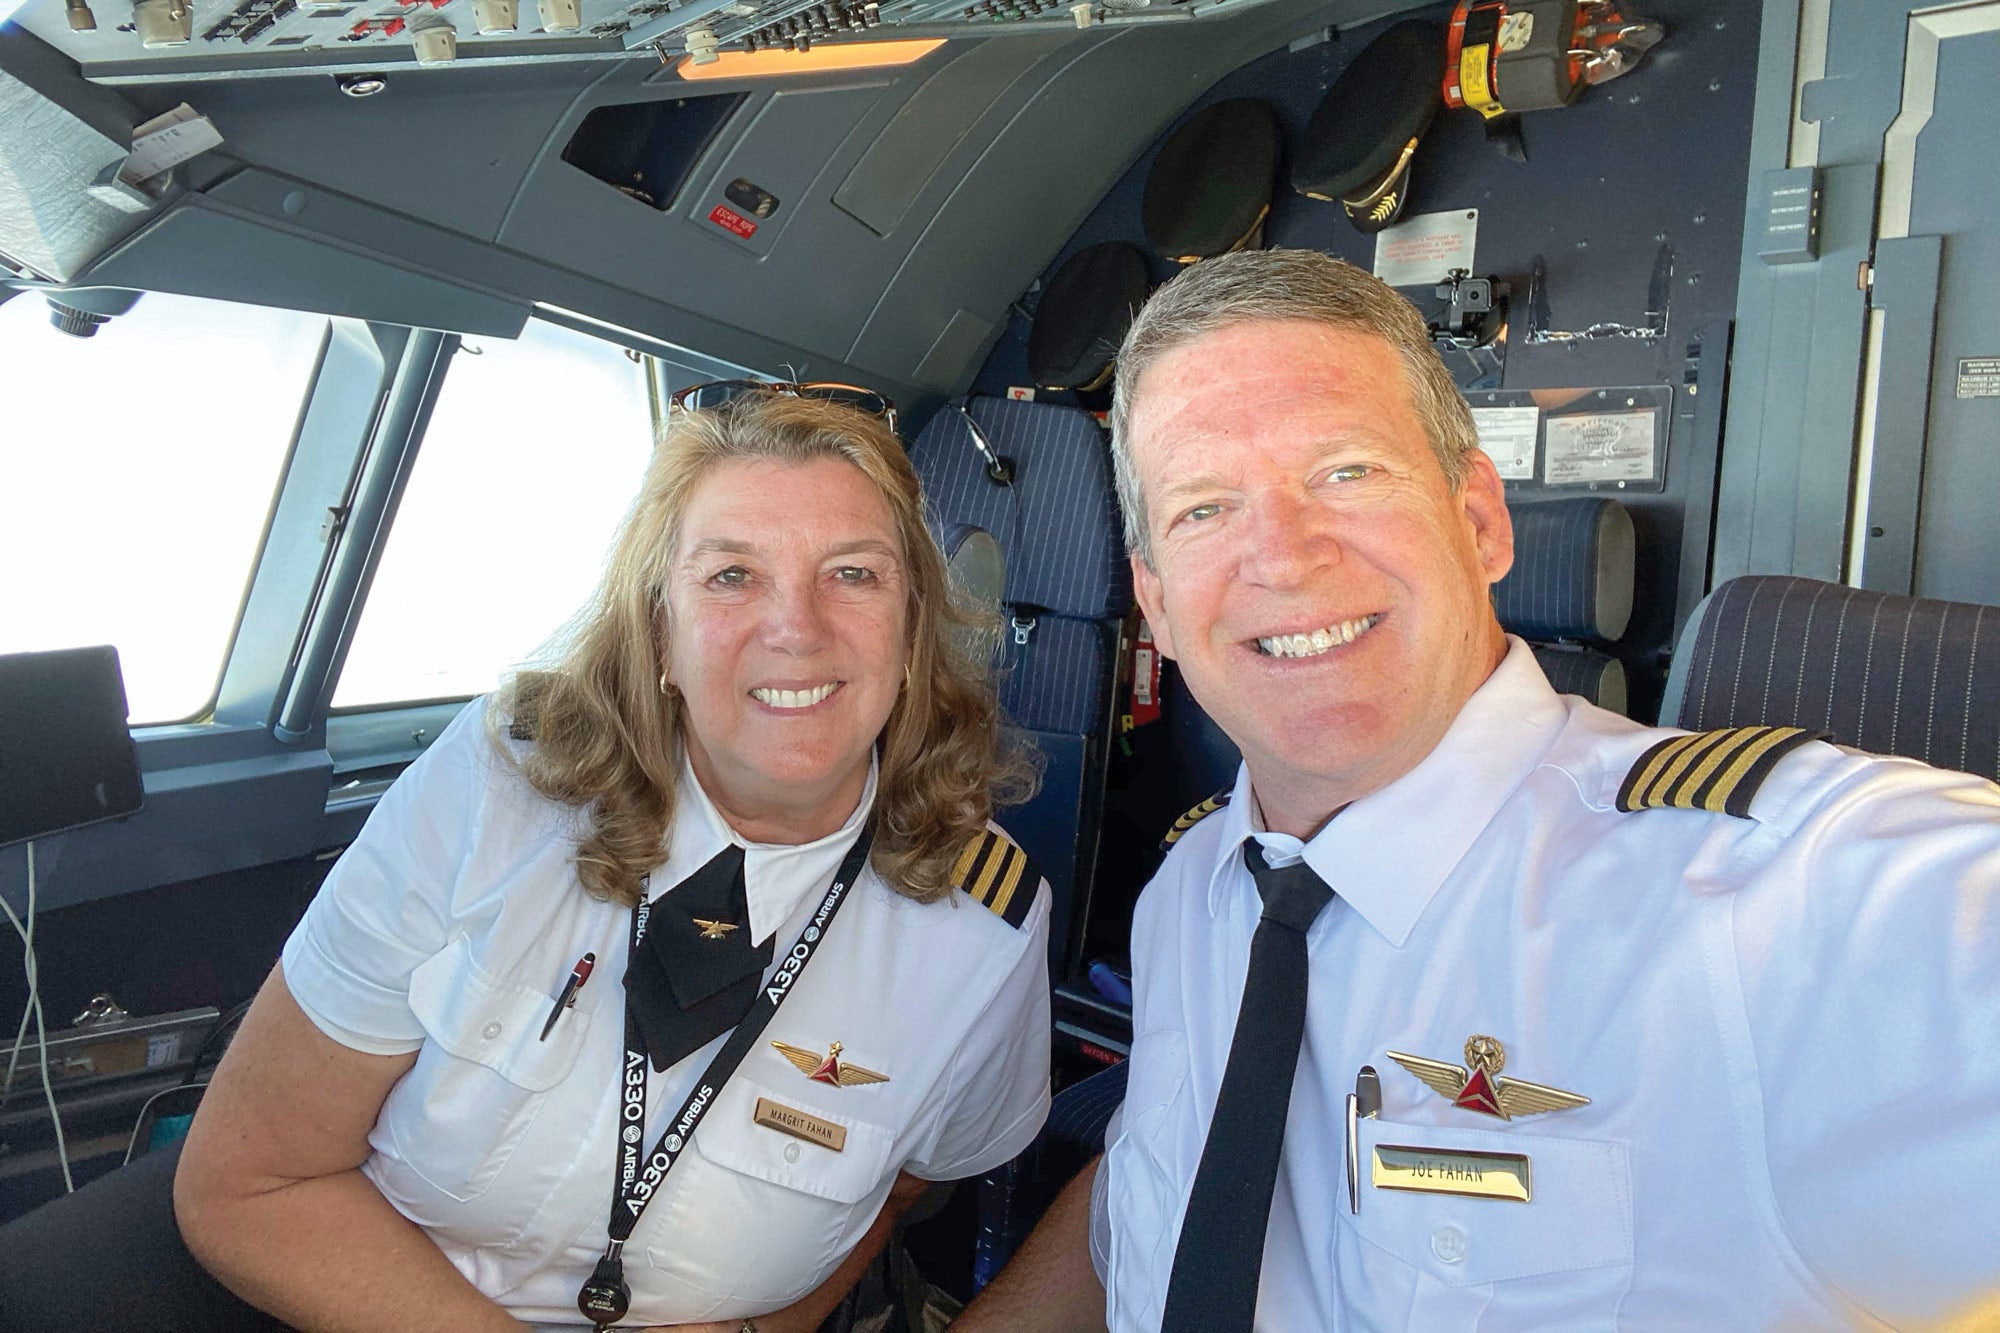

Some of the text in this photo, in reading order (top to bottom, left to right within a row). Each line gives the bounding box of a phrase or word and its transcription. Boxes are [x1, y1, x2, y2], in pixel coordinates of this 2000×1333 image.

[717, 208, 739, 224] ESCAPE
[740, 220, 755, 232] ROPE
[766, 881, 844, 1005] A330 AIRBUS
[624, 1050, 644, 1121] A330
[770, 1109, 833, 1139] MARGRIT FAHAN
[626, 1084, 713, 1217] A330 AIRBUS
[1411, 1161, 1483, 1182] JOE FAHAN
